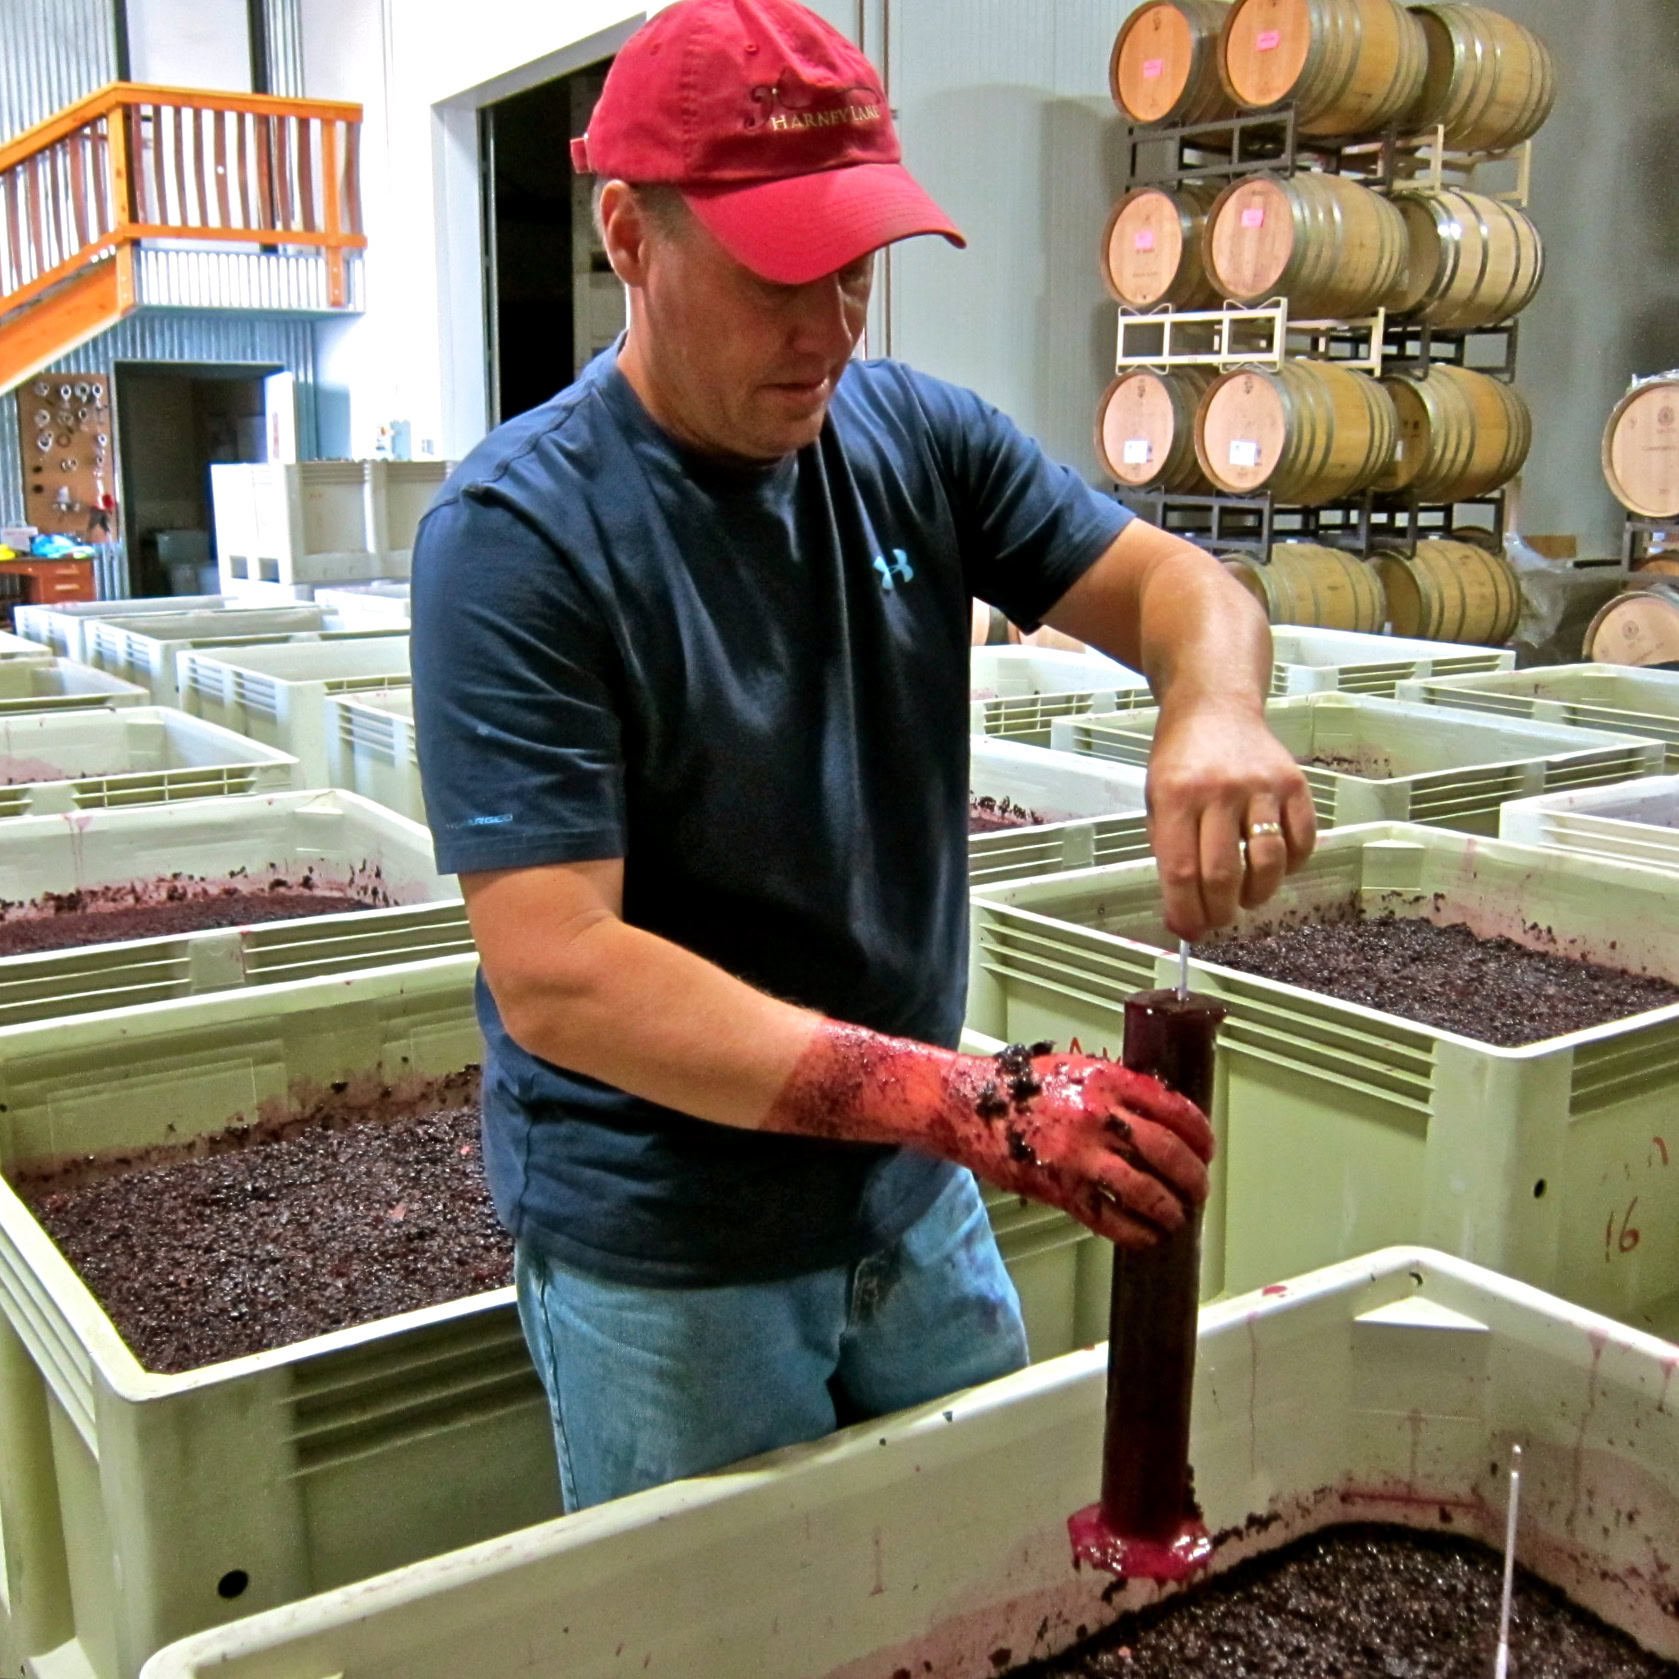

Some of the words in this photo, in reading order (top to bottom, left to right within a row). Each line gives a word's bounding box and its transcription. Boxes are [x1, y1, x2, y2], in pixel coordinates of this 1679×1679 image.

[770, 110, 849, 131] HARNEY
[850, 105, 880, 121] LANE
[1605, 1195, 1641, 1263] 16
